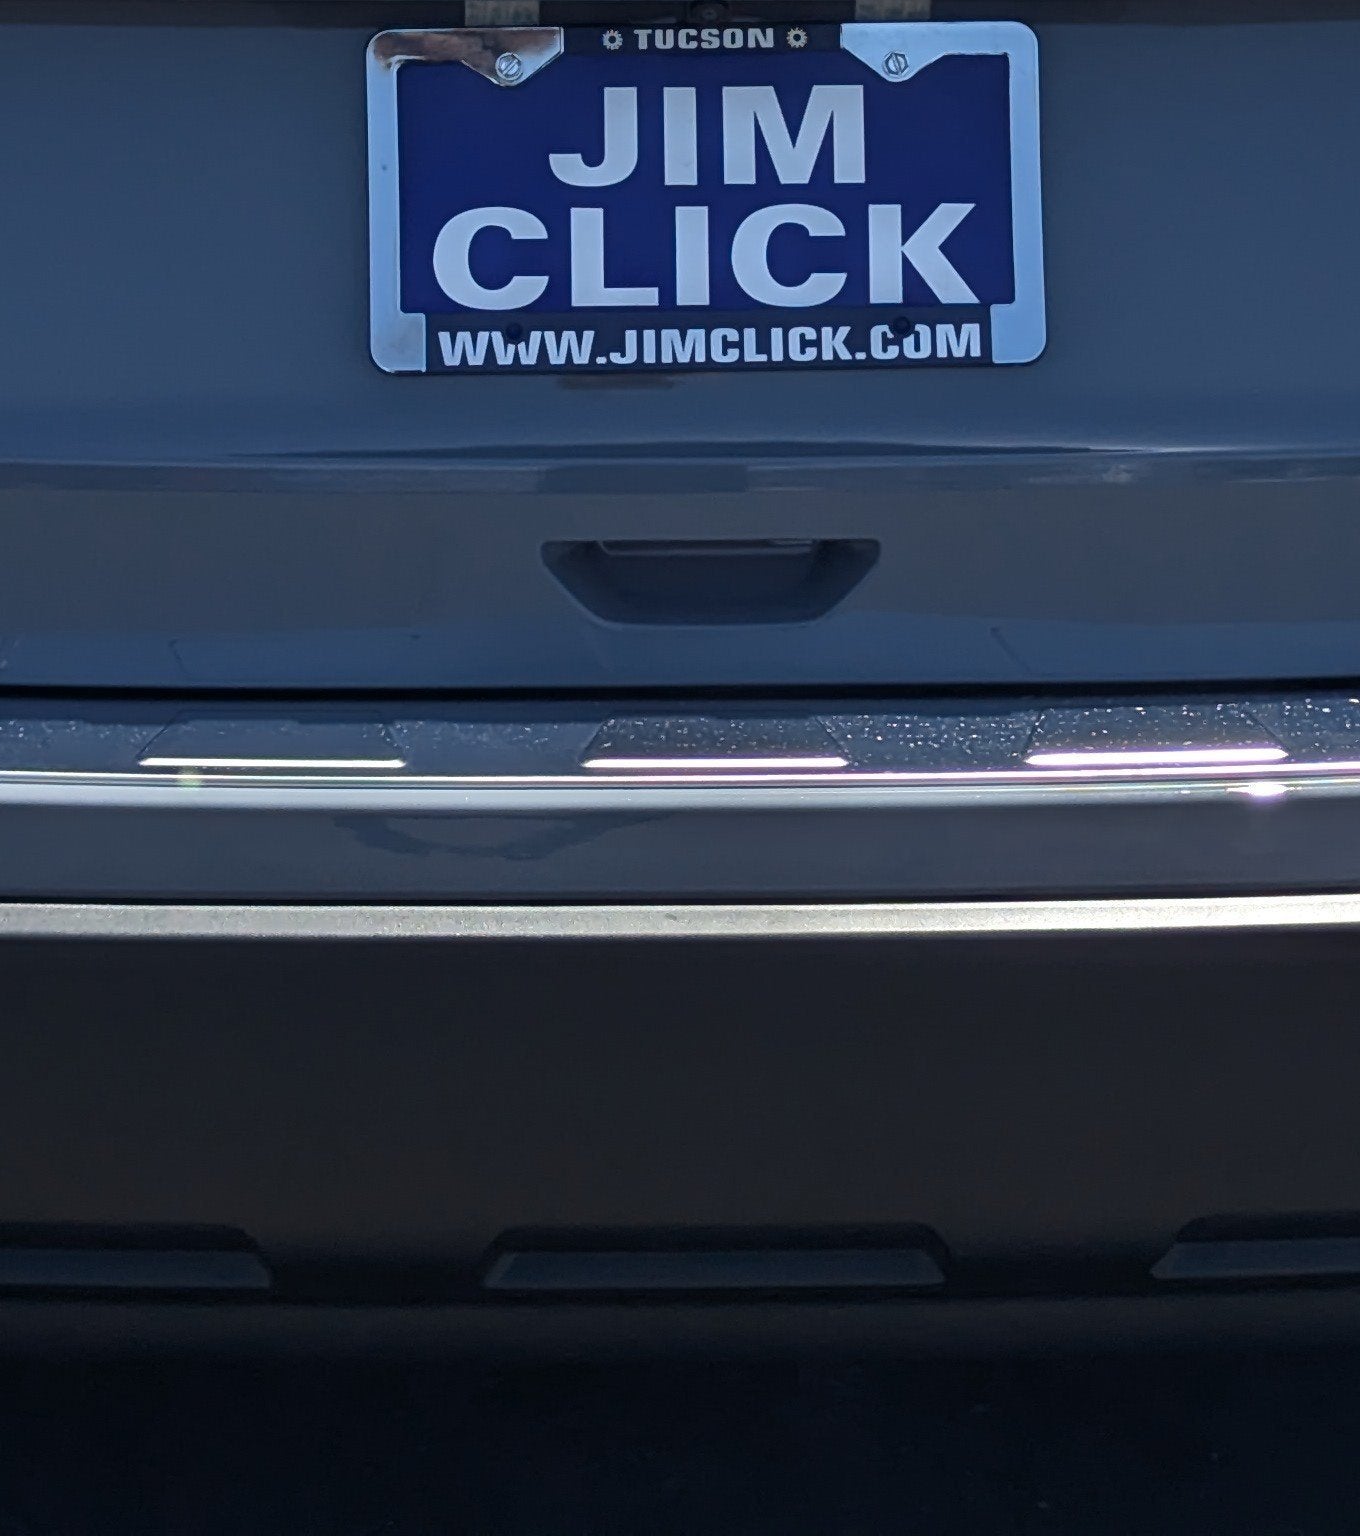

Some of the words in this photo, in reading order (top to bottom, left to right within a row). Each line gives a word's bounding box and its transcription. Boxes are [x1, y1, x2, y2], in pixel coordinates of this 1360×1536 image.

[633, 27, 776, 51] TUCSON
[548, 84, 866, 187] JIM
[431, 202, 982, 311] CLICK
[437, 322, 983, 367] WWW.JIMCLICK.COM
